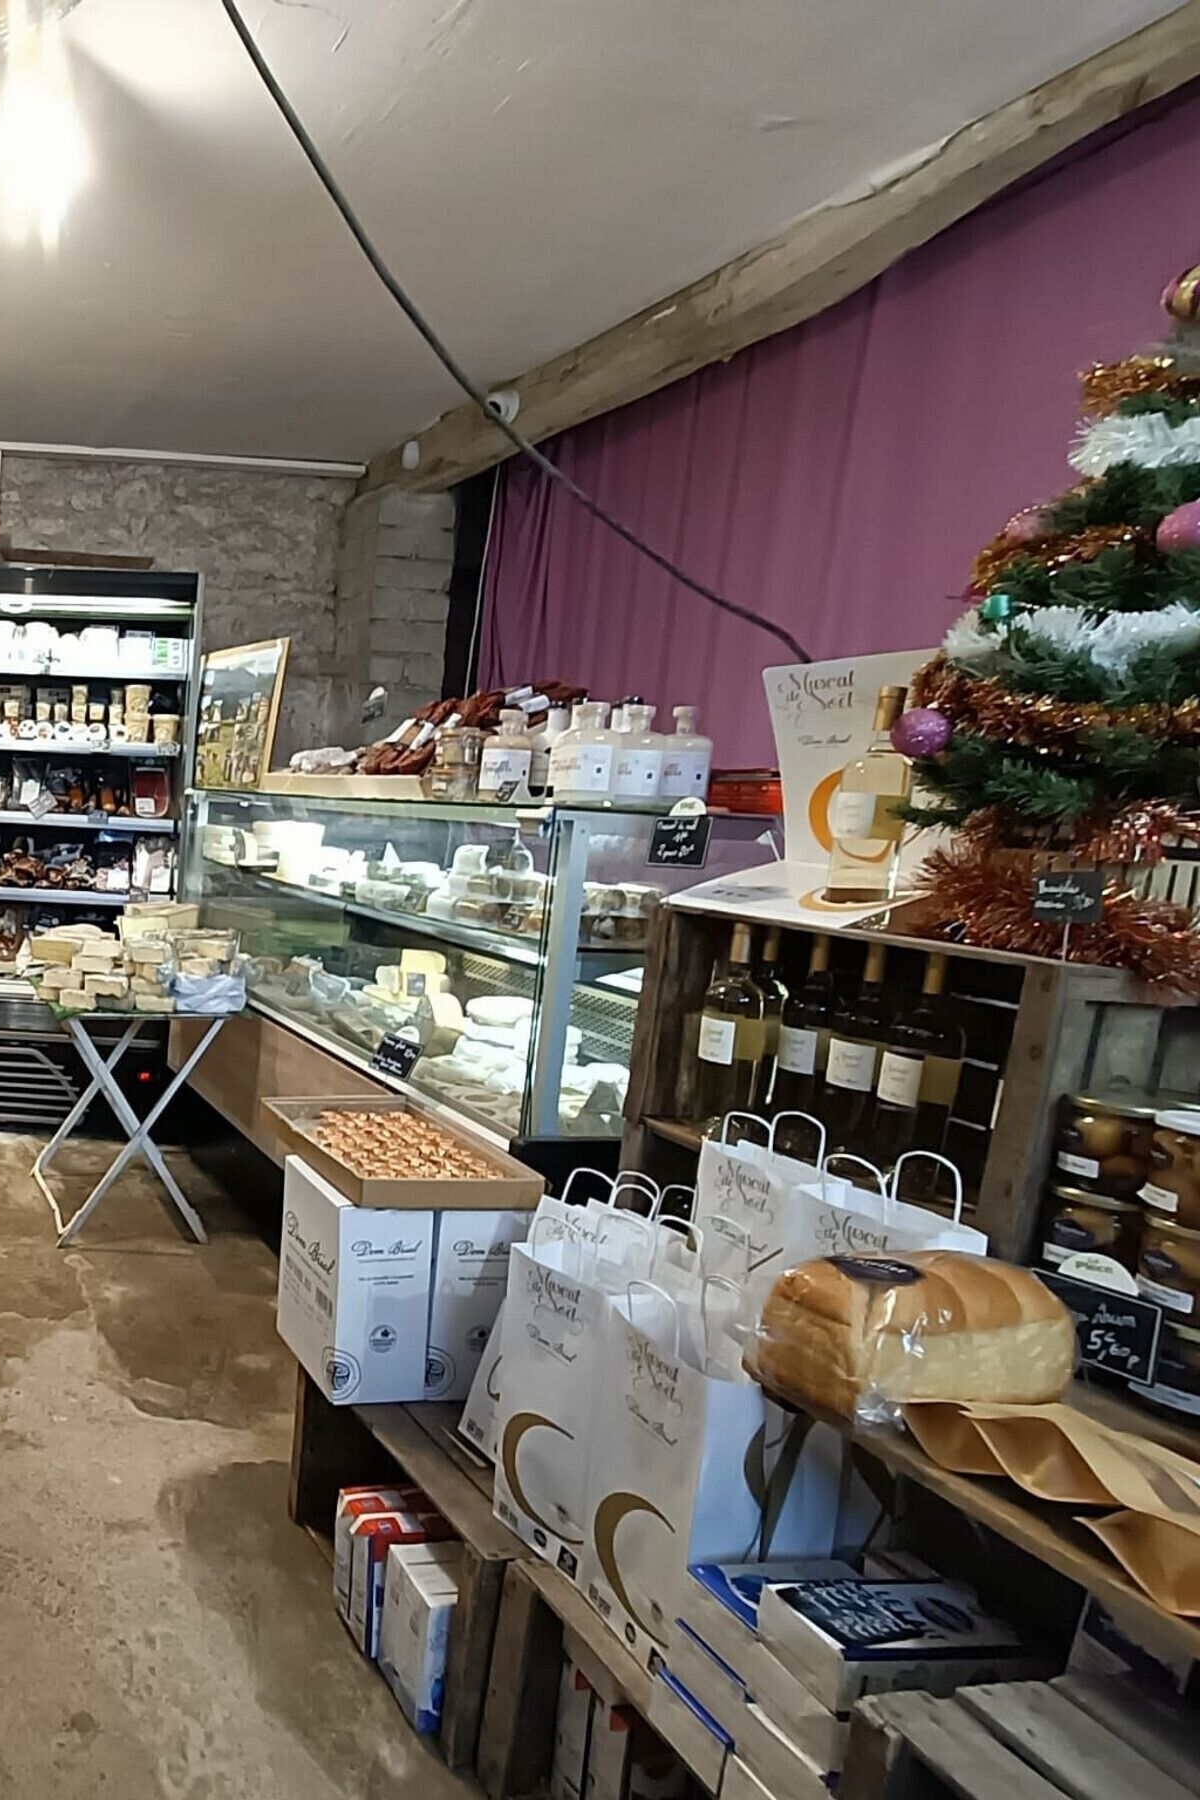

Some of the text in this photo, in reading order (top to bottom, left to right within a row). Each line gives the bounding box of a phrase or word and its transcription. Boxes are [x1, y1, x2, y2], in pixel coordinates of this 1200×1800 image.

[778, 670, 854, 694] Muscat
[285, 1210, 306, 1249] Dom
[819, 1211, 890, 1249] Muscat
[351, 1240, 423, 1257] Dom Brial
[453, 1240, 486, 1257] Dom
